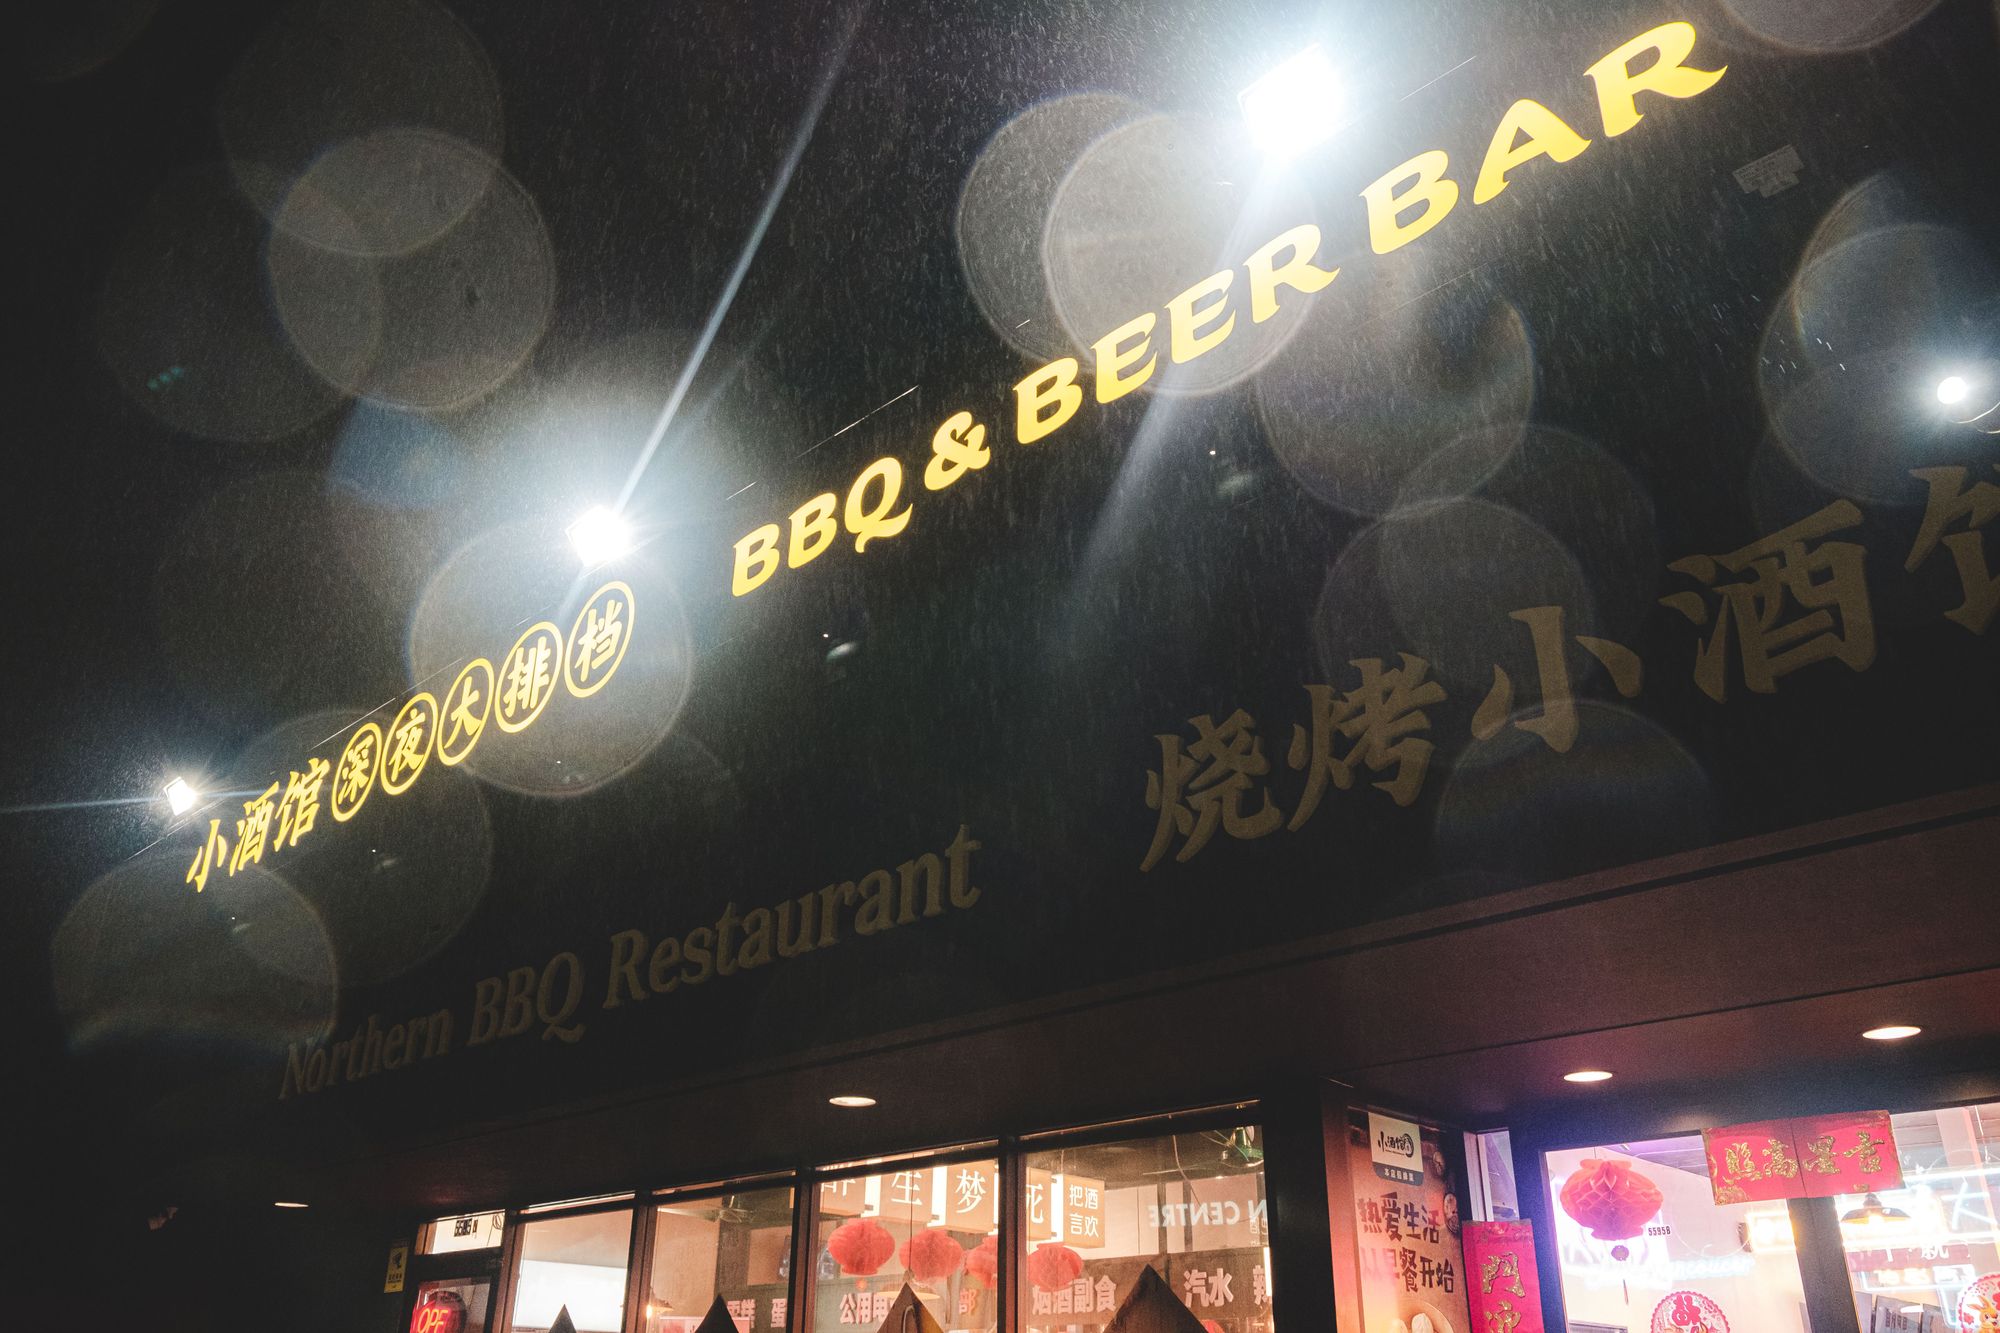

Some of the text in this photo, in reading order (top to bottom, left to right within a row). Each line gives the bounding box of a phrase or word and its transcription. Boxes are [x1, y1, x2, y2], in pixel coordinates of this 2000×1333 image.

[732, 20, 1728, 597] BBQ & BEER BAR
[278, 824, 982, 1100] Northern BBQ Restaurant
[1183, 1268, 1234, 1308] 汽水
[1357, 1191, 1440, 1244] 热爱生活
